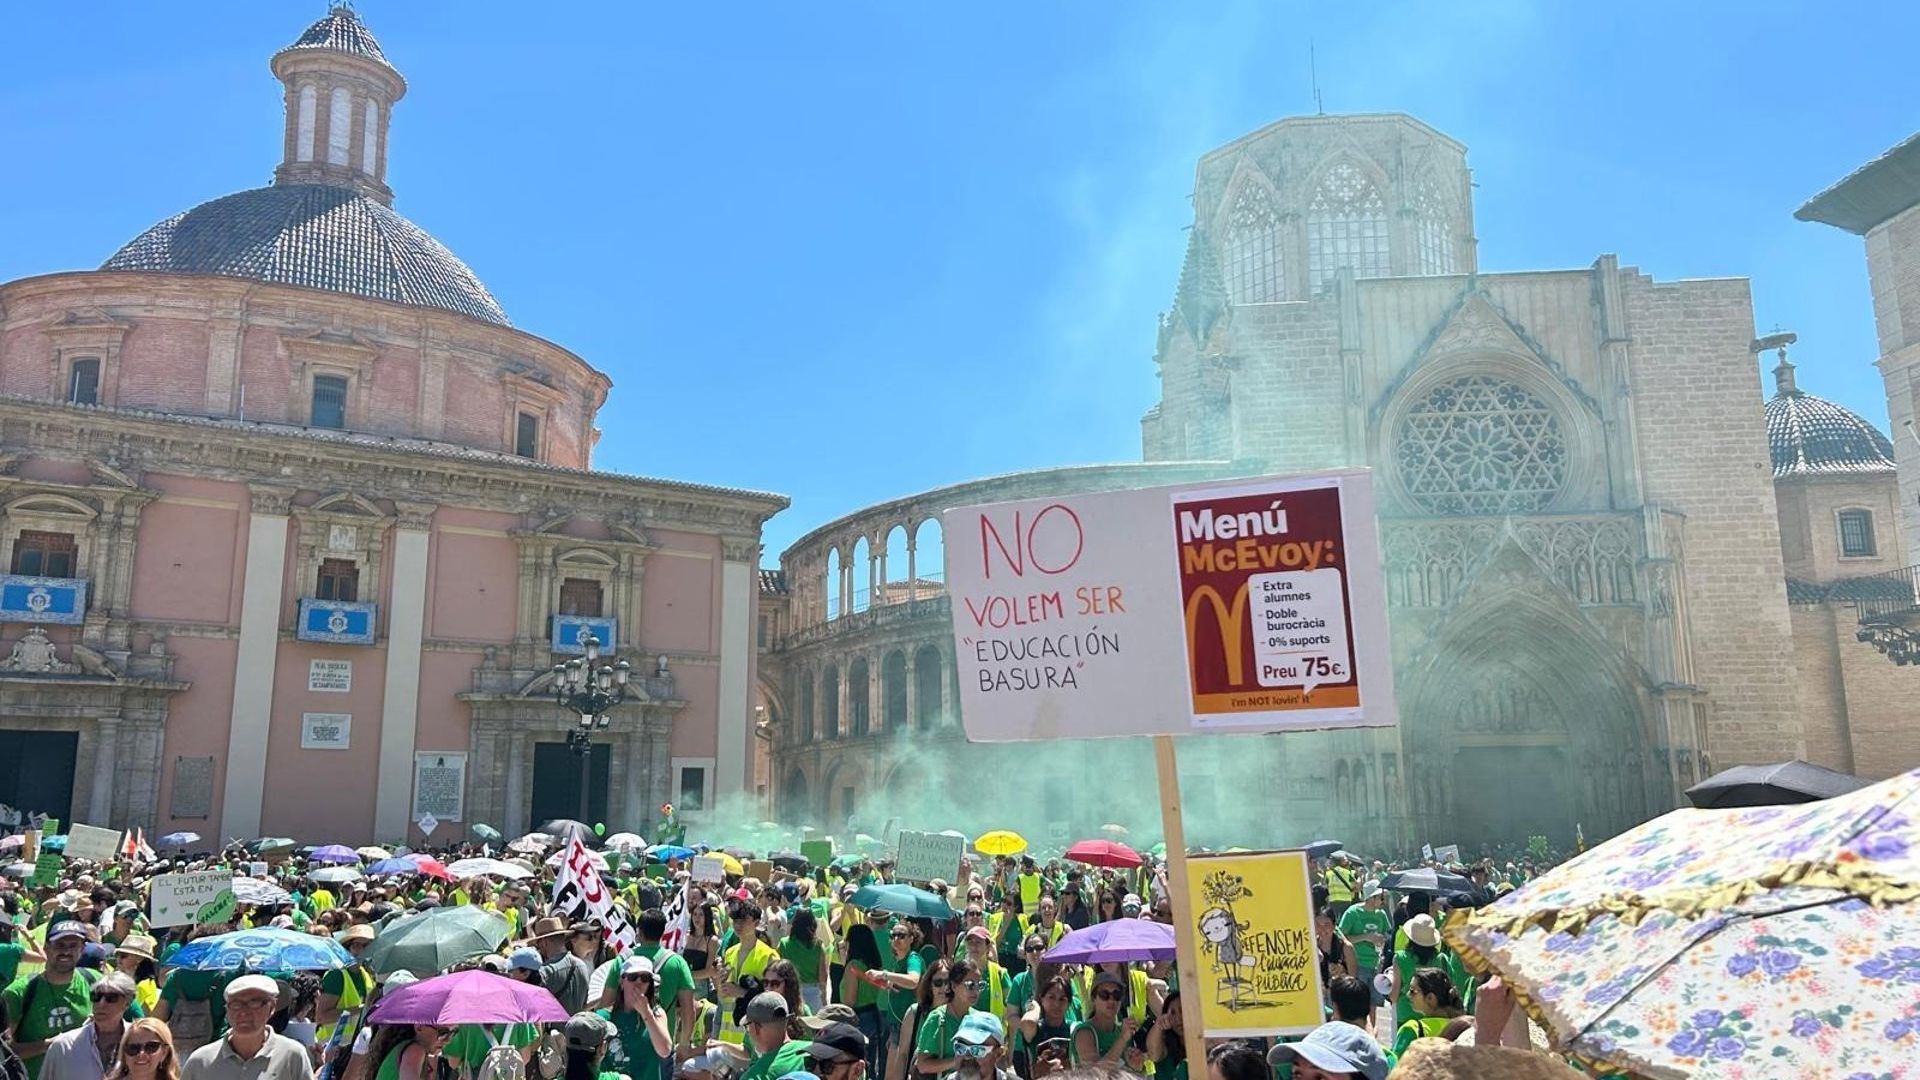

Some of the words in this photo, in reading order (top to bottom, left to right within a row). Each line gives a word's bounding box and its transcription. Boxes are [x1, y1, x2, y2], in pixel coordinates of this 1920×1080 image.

[1180, 500, 1289, 544] Menú
[980, 503, 1084, 580] NO
[1182, 537, 1336, 575] McEvoy:
[1262, 580, 1293, 592] Extra
[1264, 591, 1312, 604] alumnes
[964, 591, 1064, 629] VOLEM
[1075, 585, 1127, 616] SER
[1265, 607, 1298, 620] Doble
[1266, 616, 1326, 632] burocràcia
[1268, 636, 1288, 648] 0%
[1289, 634, 1331, 648] suports
[1262, 664, 1298, 680] Preu
[1248, 696, 1270, 706] NOT
[158, 878, 172, 887] EL
[178, 876, 206, 885] FUTUR
[198, 885, 213, 894] EN
[178, 898, 200, 907] VAGA
